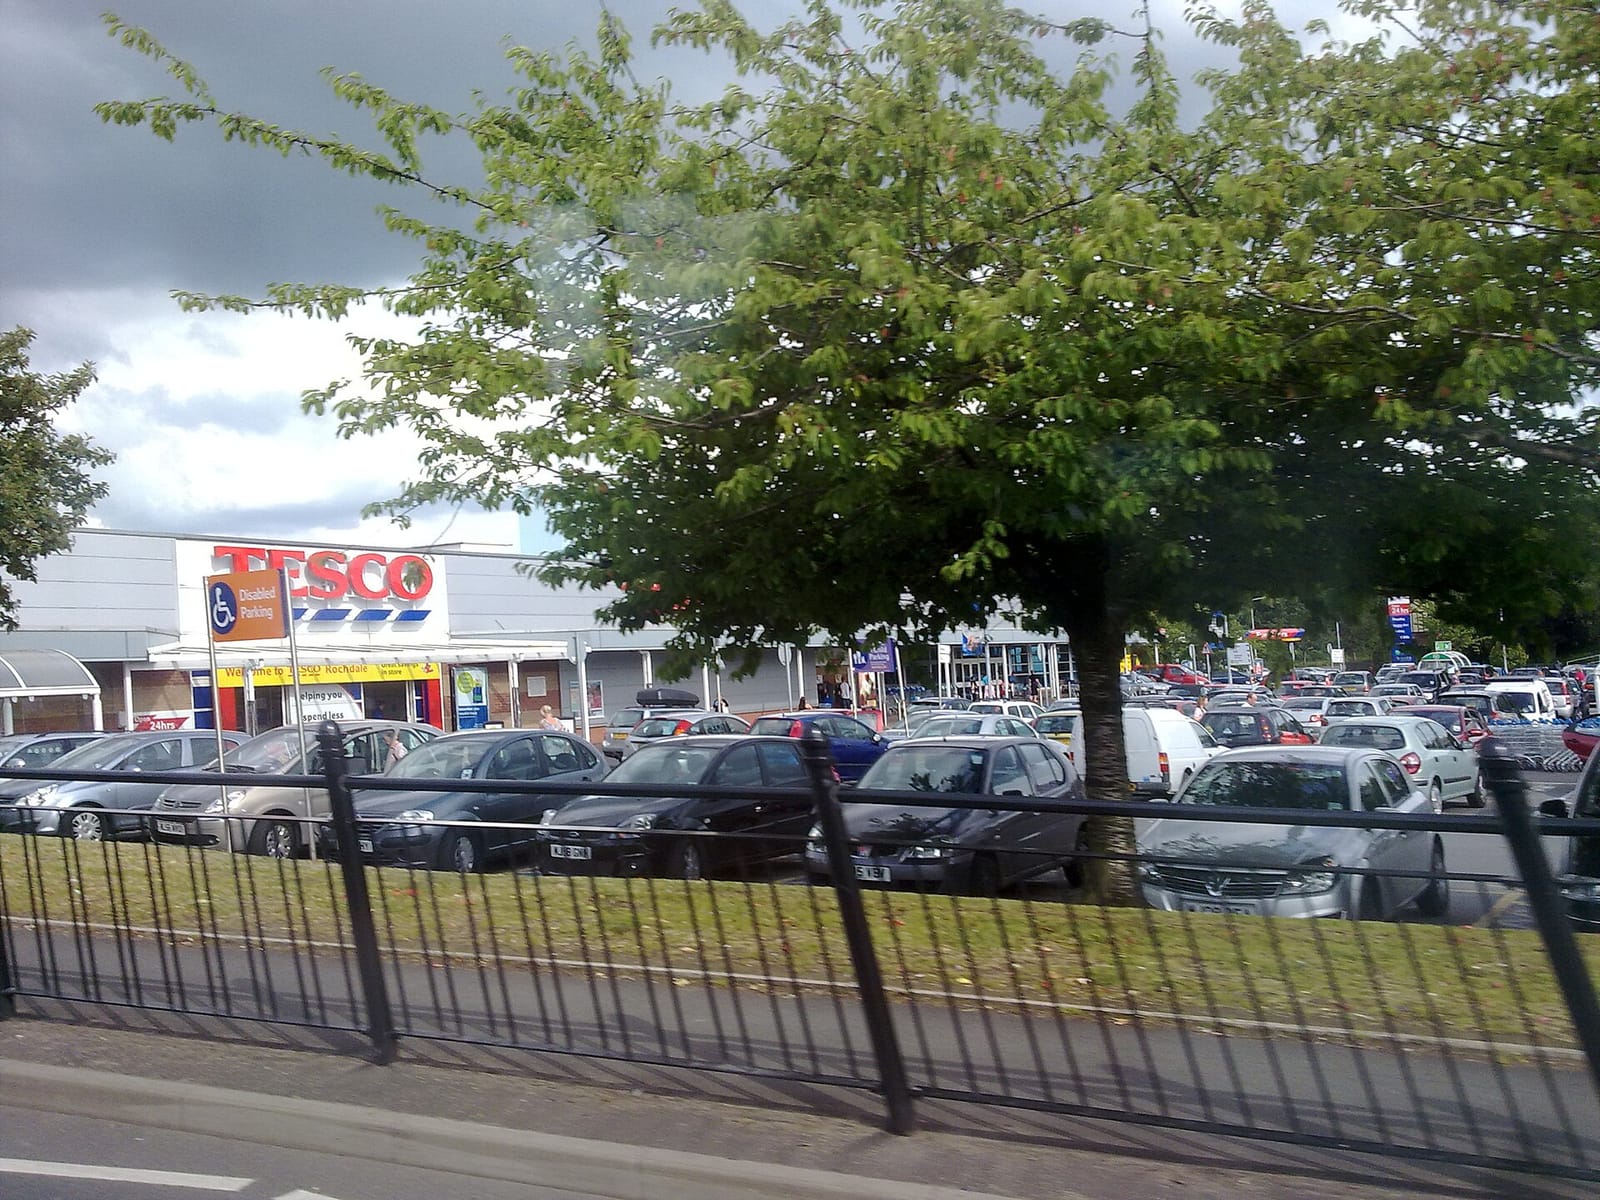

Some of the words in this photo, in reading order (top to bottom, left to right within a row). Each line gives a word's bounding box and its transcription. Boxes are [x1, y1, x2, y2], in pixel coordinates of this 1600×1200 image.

[213, 545, 433, 600] TESCO
[240, 586, 276, 601] Disabled
[240, 605, 273, 620] Parking
[225, 666, 272, 677] Welome
[274, 665, 284, 675] to
[288, 664, 321, 677] TSCO
[325, 664, 368, 674] Rochdale
[300, 692, 326, 701] elping
[327, 692, 343, 700] you
[303, 712, 327, 721] spend
[328, 711, 344, 720] less
[149, 721, 176, 730] 24hrs
